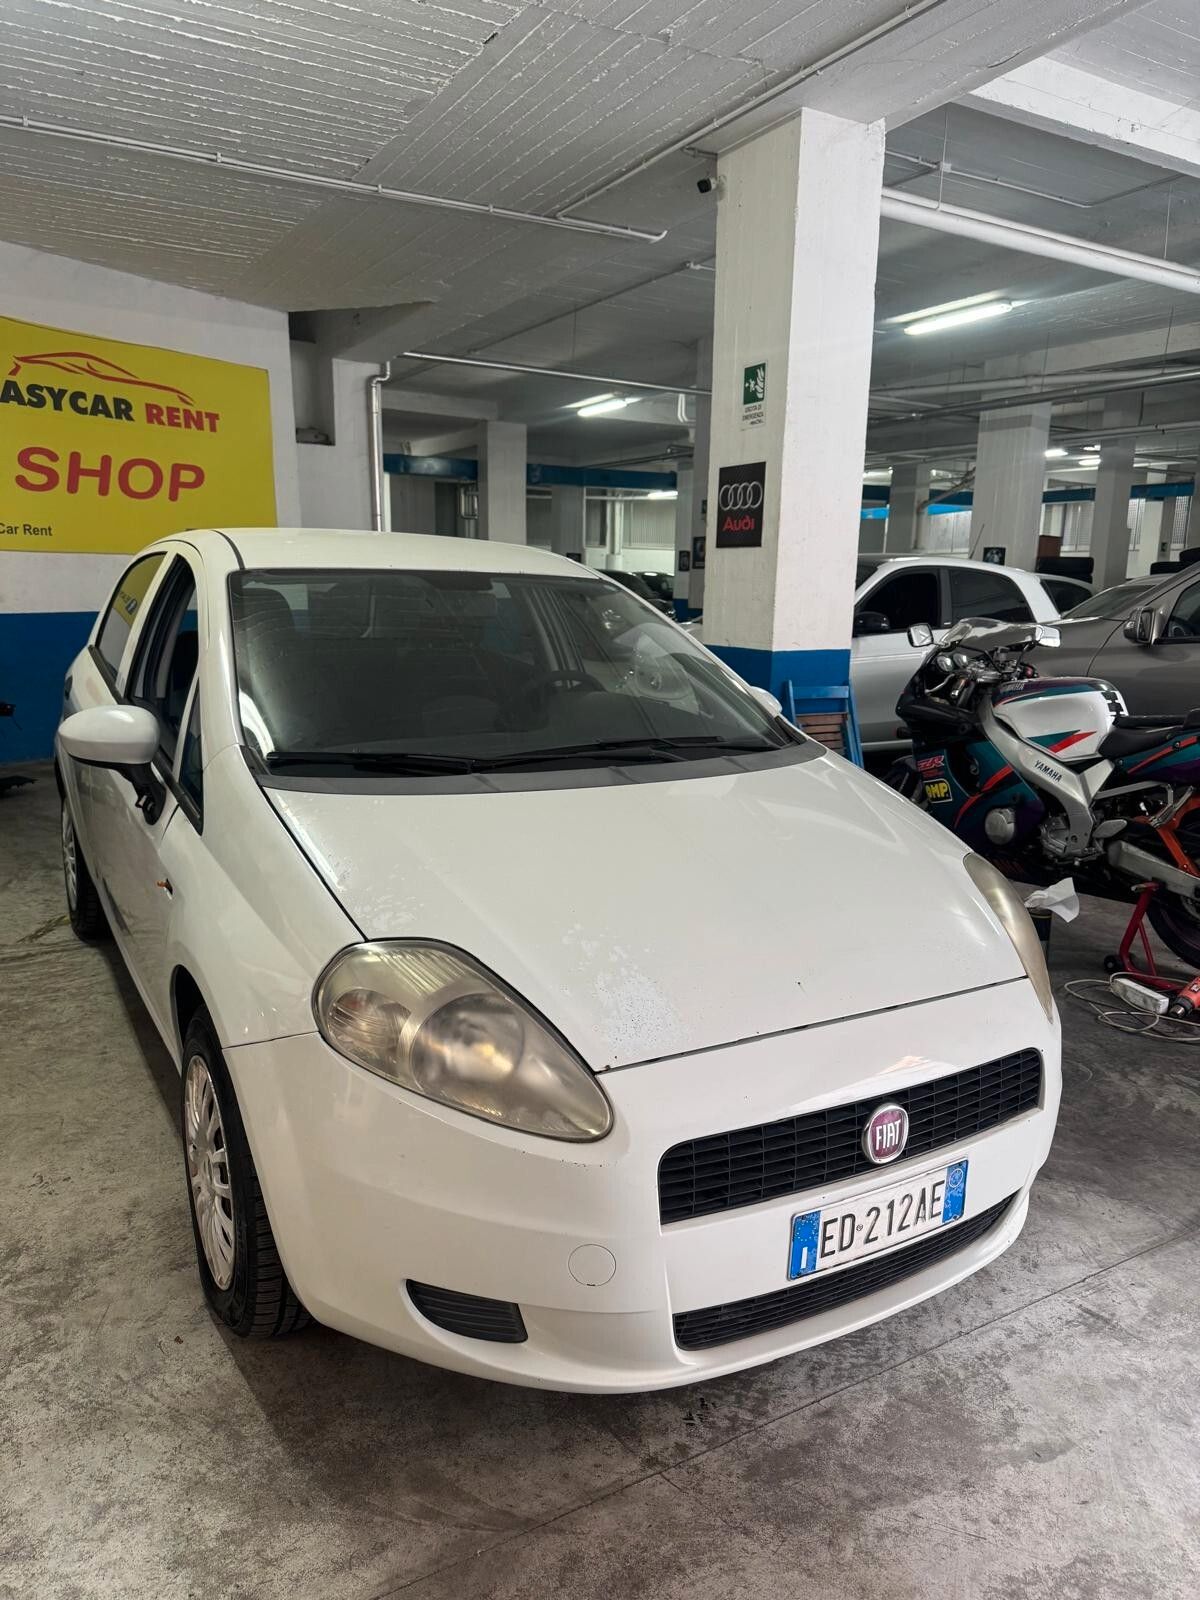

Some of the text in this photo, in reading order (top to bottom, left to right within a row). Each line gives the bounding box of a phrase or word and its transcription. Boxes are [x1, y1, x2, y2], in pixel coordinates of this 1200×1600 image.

[145, 403, 219, 432] RENT
[15, 446, 205, 501] SHOP
[22, 523, 53, 537] Rent
[723, 516, 754, 531] Audi
[1034, 759, 1063, 782] YAMAHA
[875, 1120, 901, 1150] FIAT
